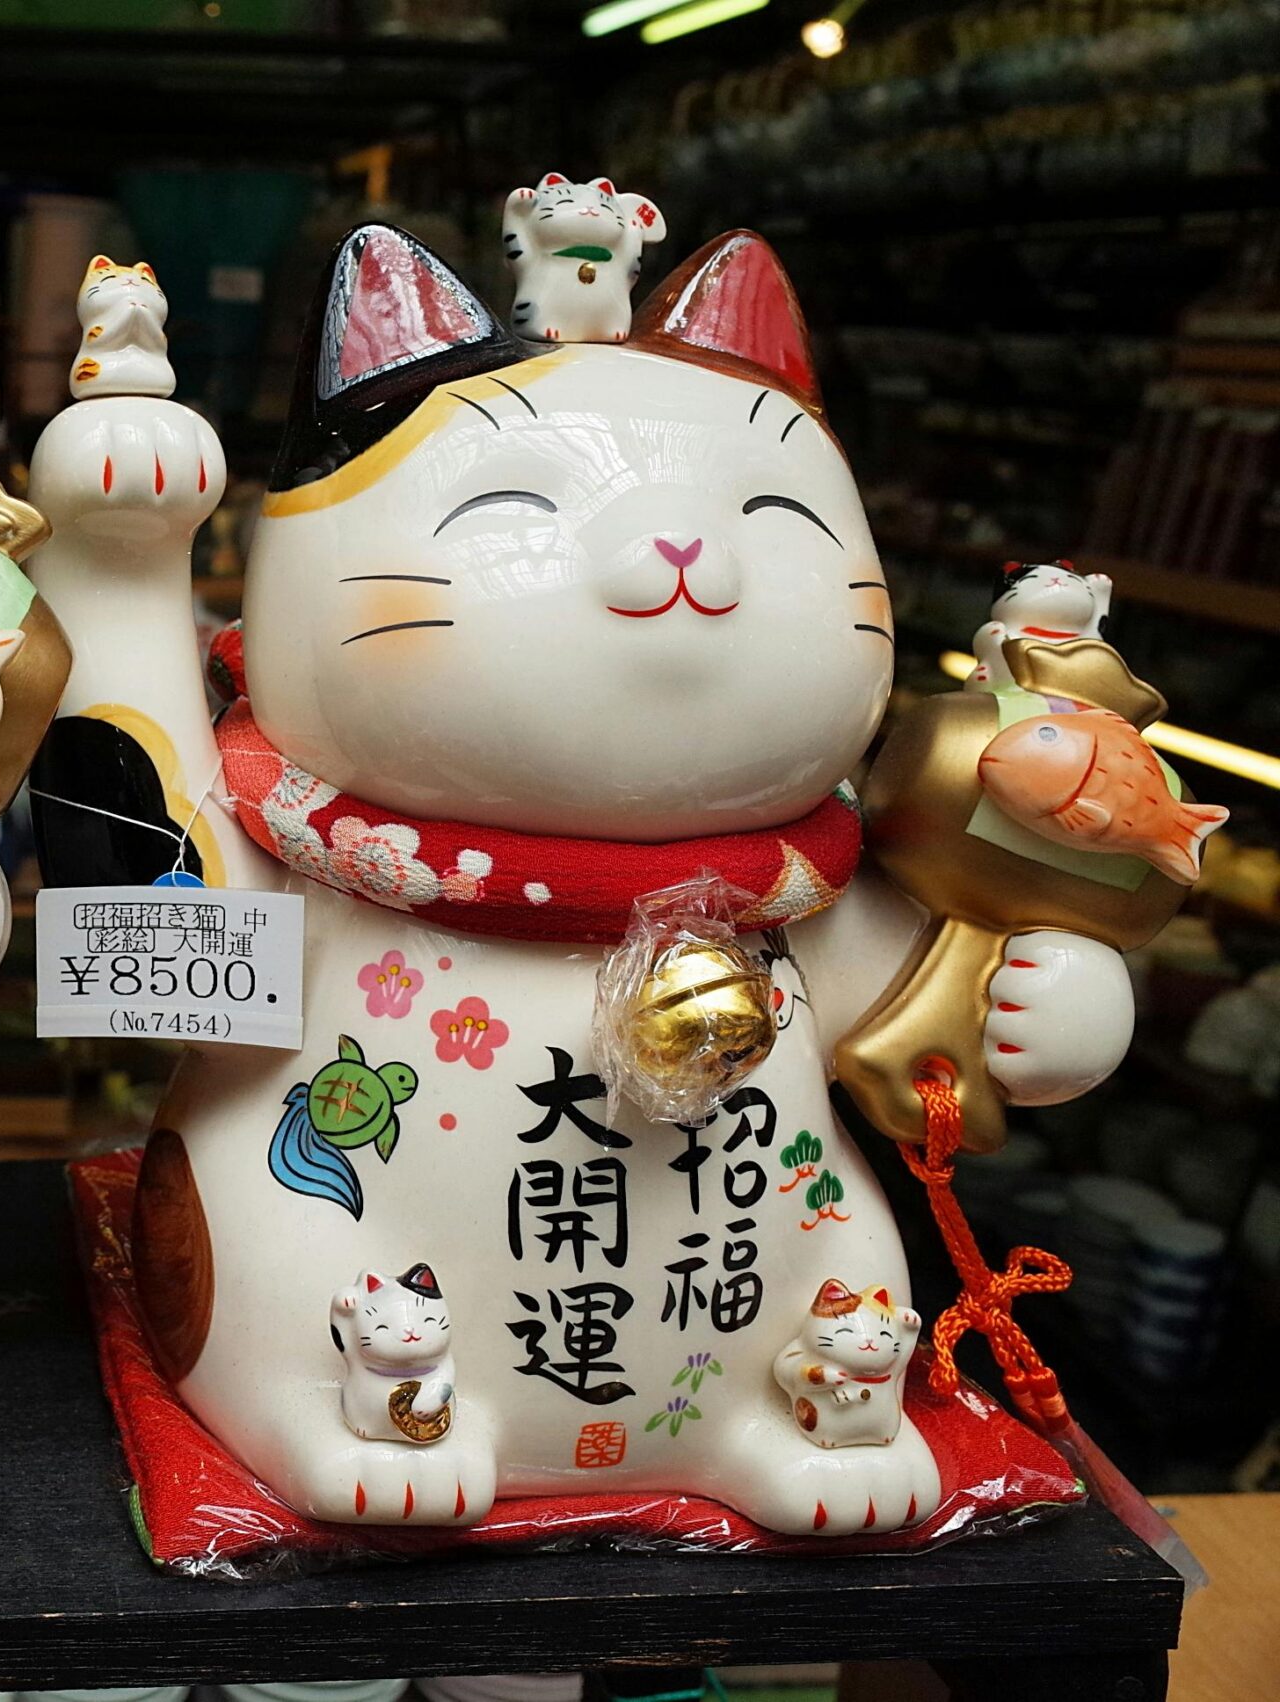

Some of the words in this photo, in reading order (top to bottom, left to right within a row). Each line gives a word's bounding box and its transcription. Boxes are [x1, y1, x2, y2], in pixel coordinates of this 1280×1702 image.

[79, 906, 218, 930] 招福招き猫
[243, 907, 267, 934] 中
[94, 928, 148, 953] 彩絵
[173, 929, 253, 957] 大開運
[505, 1046, 636, 1406] 大開運
